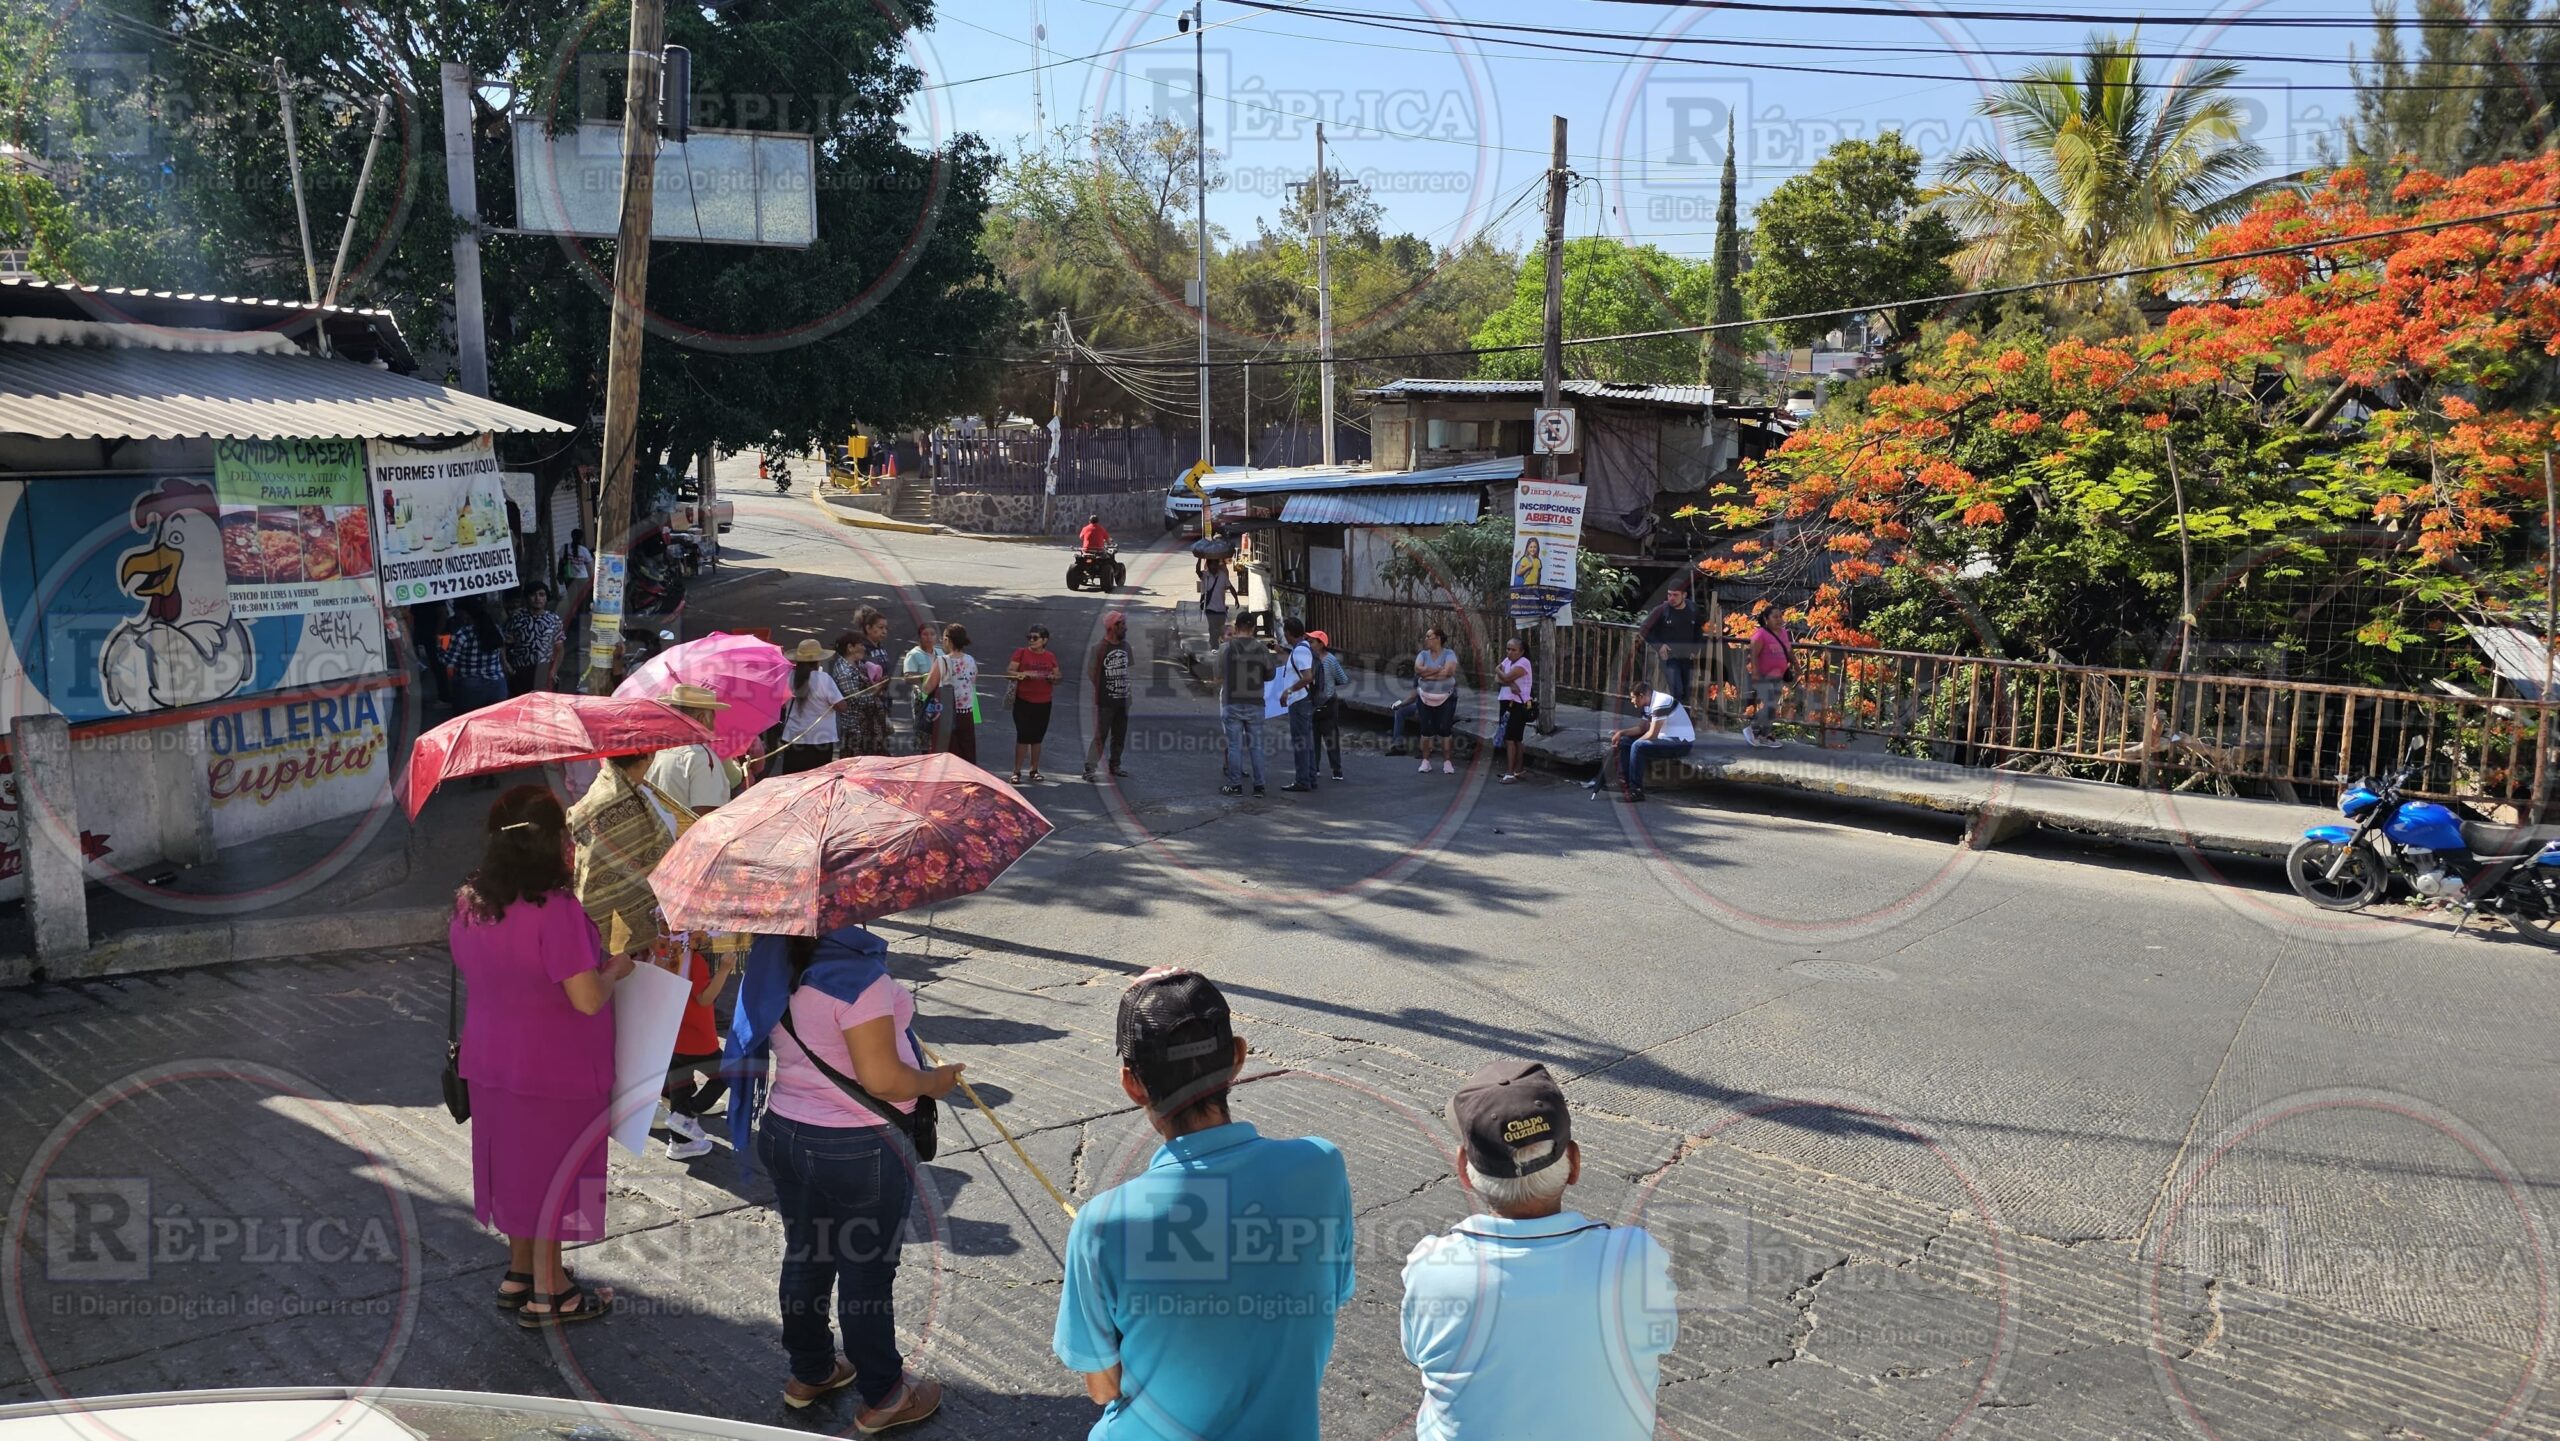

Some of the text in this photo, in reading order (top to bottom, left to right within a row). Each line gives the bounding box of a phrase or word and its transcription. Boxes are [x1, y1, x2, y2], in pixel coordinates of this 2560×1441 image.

[218, 438, 357, 467] COMIDA CASERA
[230, 470, 349, 483] DELICIOSOS PLATILLOS
[376, 465, 435, 482] INFORMES
[437, 464, 444, 479] Y
[261, 486, 333, 499] PARA LLEVAR
[1519, 503, 1582, 515] INSCRIPCIONES
[1525, 512, 1573, 525] ABIERTAS
[383, 547, 513, 583] DISTRIBUIDOR INDEPENDIENTE
[229, 591, 259, 601] ERVICIO
[260, 590, 270, 600] DE
[293, 588, 319, 599] VIERNES
[209, 689, 380, 756] OLLERIA
[1504, 1122, 1550, 1142] Guzman
[1508, 1116, 1543, 1132] Chapo
